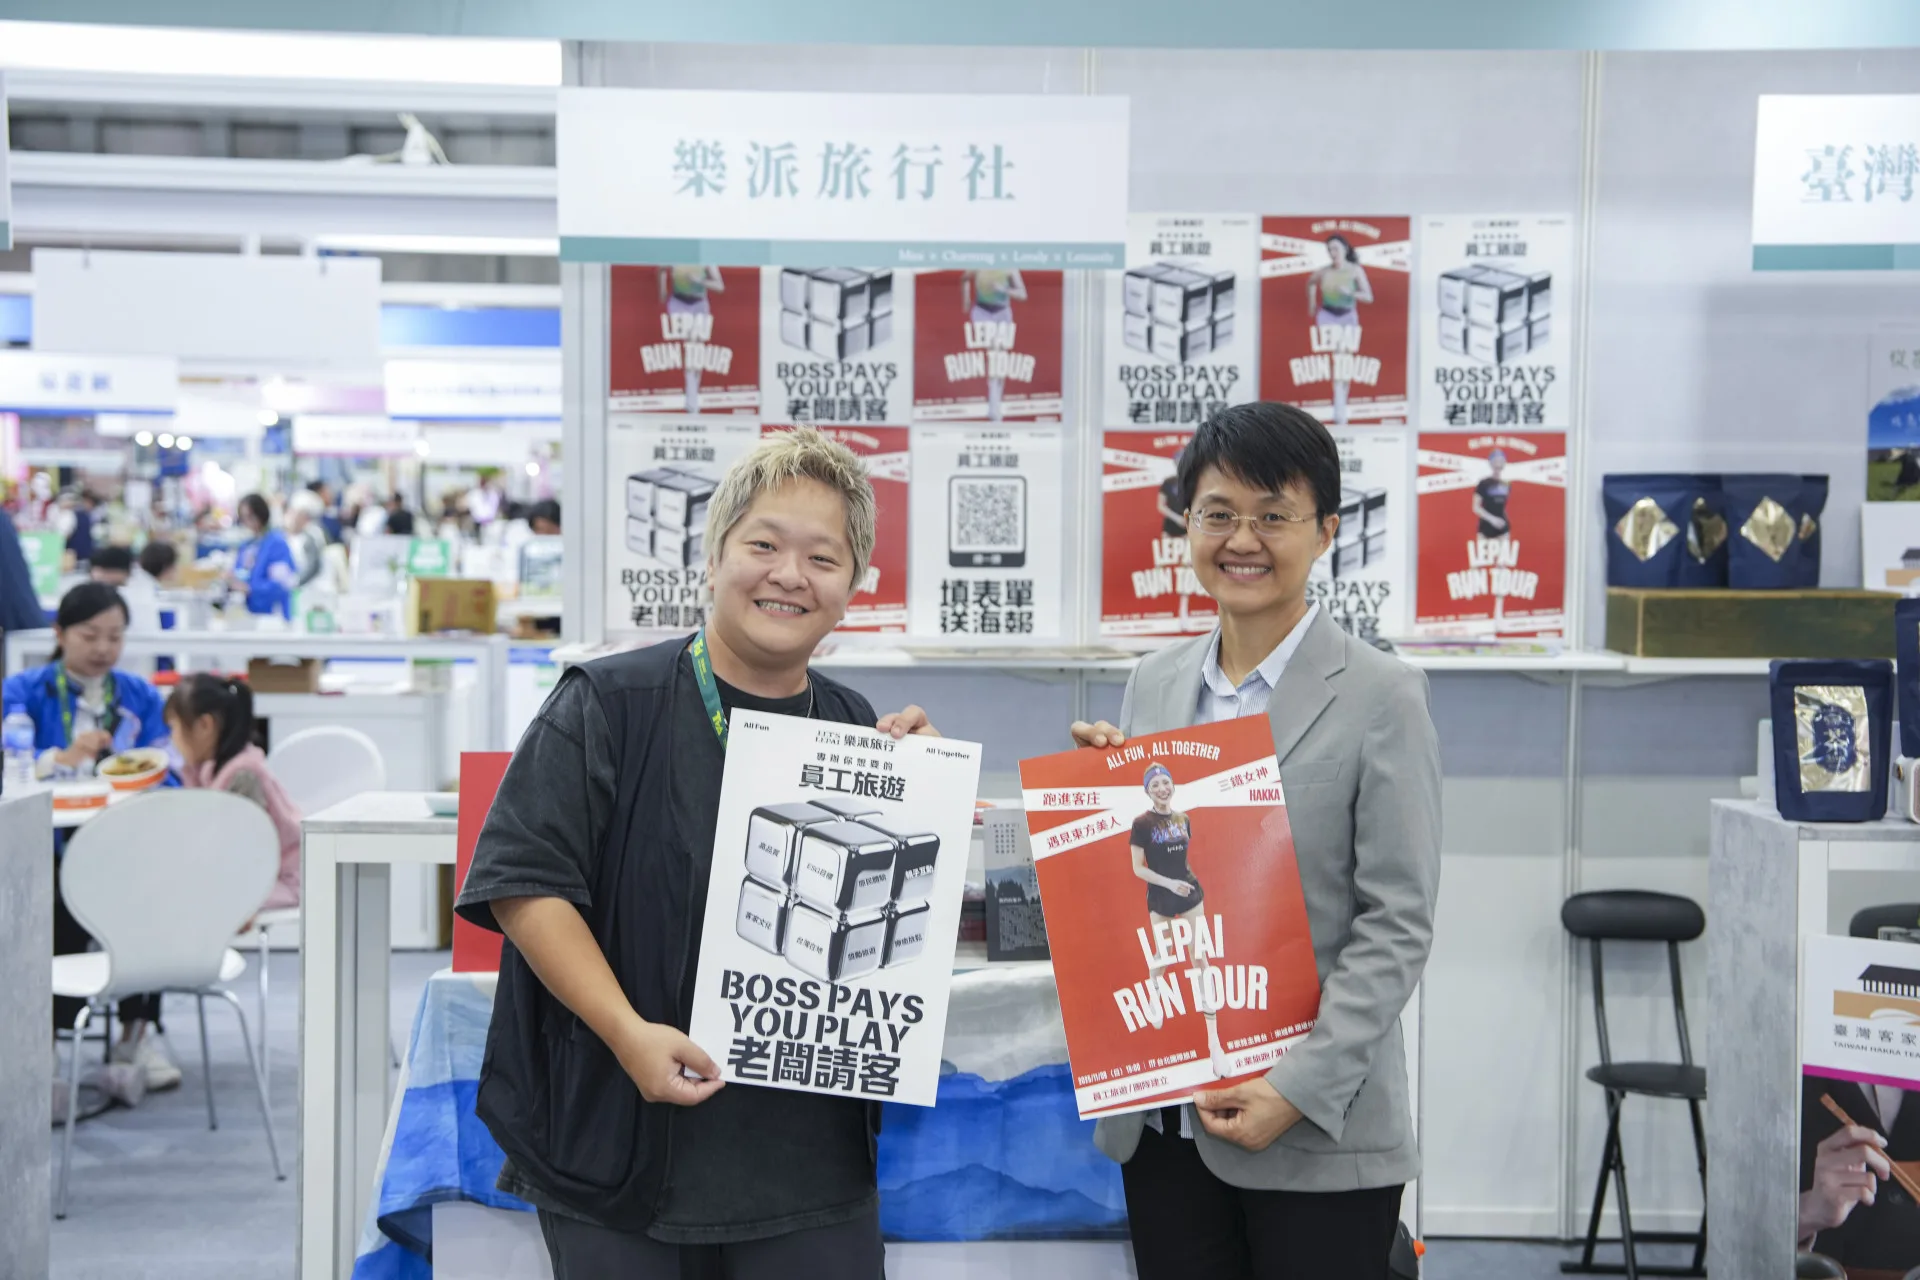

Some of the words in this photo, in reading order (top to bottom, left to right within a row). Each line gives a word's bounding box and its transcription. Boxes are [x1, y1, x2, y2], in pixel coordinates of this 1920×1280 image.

[673, 138, 1016, 202] 樂派旅行社
[660, 312, 714, 341] LEPAI
[964, 321, 1016, 350] LEPAI
[1309, 324, 1362, 353] LEPAI
[640, 342, 682, 374] RUN
[684, 342, 734, 376] TOUR
[777, 362, 835, 379] BOSS
[840, 362, 897, 379] PAYS
[944, 350, 985, 382] RUN
[986, 350, 1036, 383] TOUR
[1120, 365, 1176, 381] BOSS
[1182, 364, 1239, 381] PAYS
[1289, 354, 1331, 386] RUN
[1332, 353, 1381, 386] TOUR
[1435, 366, 1493, 383] BOSS
[1498, 365, 1555, 382] PAYS
[784, 380, 829, 397] YOU
[835, 380, 891, 397] PLAY
[1127, 382, 1171, 399] YOU
[1178, 382, 1232, 399] PLAY
[1442, 384, 1488, 401] YOU
[1494, 384, 1550, 400] PLAY
[1467, 539, 1520, 567] LEPAI
[621, 569, 679, 585] BOSS
[1131, 567, 1173, 598] RUN
[1334, 581, 1390, 597] PAYS
[1447, 568, 1488, 600] RUN
[1489, 567, 1539, 600] TOUR
[629, 586, 674, 602] YOU
[1328, 599, 1383, 615] PLAY
[743, 721, 755, 730] All
[756, 723, 770, 732] Fun
[844, 733, 896, 753] 樂派旅行
[925, 746, 935, 755] All
[936, 748, 971, 761] Together
[1106, 750, 1125, 771] ALL
[1126, 745, 1145, 763] FUN
[1152, 742, 1170, 757] ALL
[1171, 740, 1221, 762] TOGETHER
[799, 763, 906, 802] 員工旅遊
[1218, 765, 1269, 793] 三鐵女神
[1043, 791, 1101, 807] 跑進客庄
[1249, 788, 1281, 802] HAKKA
[1046, 815, 1122, 850] 遇見東方美人
[1136, 913, 1224, 971] LEPAI
[720, 969, 821, 1010] BOSS
[827, 983, 924, 1024] PAYS
[1113, 972, 1187, 1034] RUN
[1184, 964, 1269, 1013] TOUR
[730, 1003, 808, 1041] YOU
[814, 1014, 910, 1053] PLAY
[1833, 1041, 1867, 1052] TAIWAN
[1870, 1046, 1901, 1056] HAKKA
[727, 1036, 901, 1096] 老闆請客
